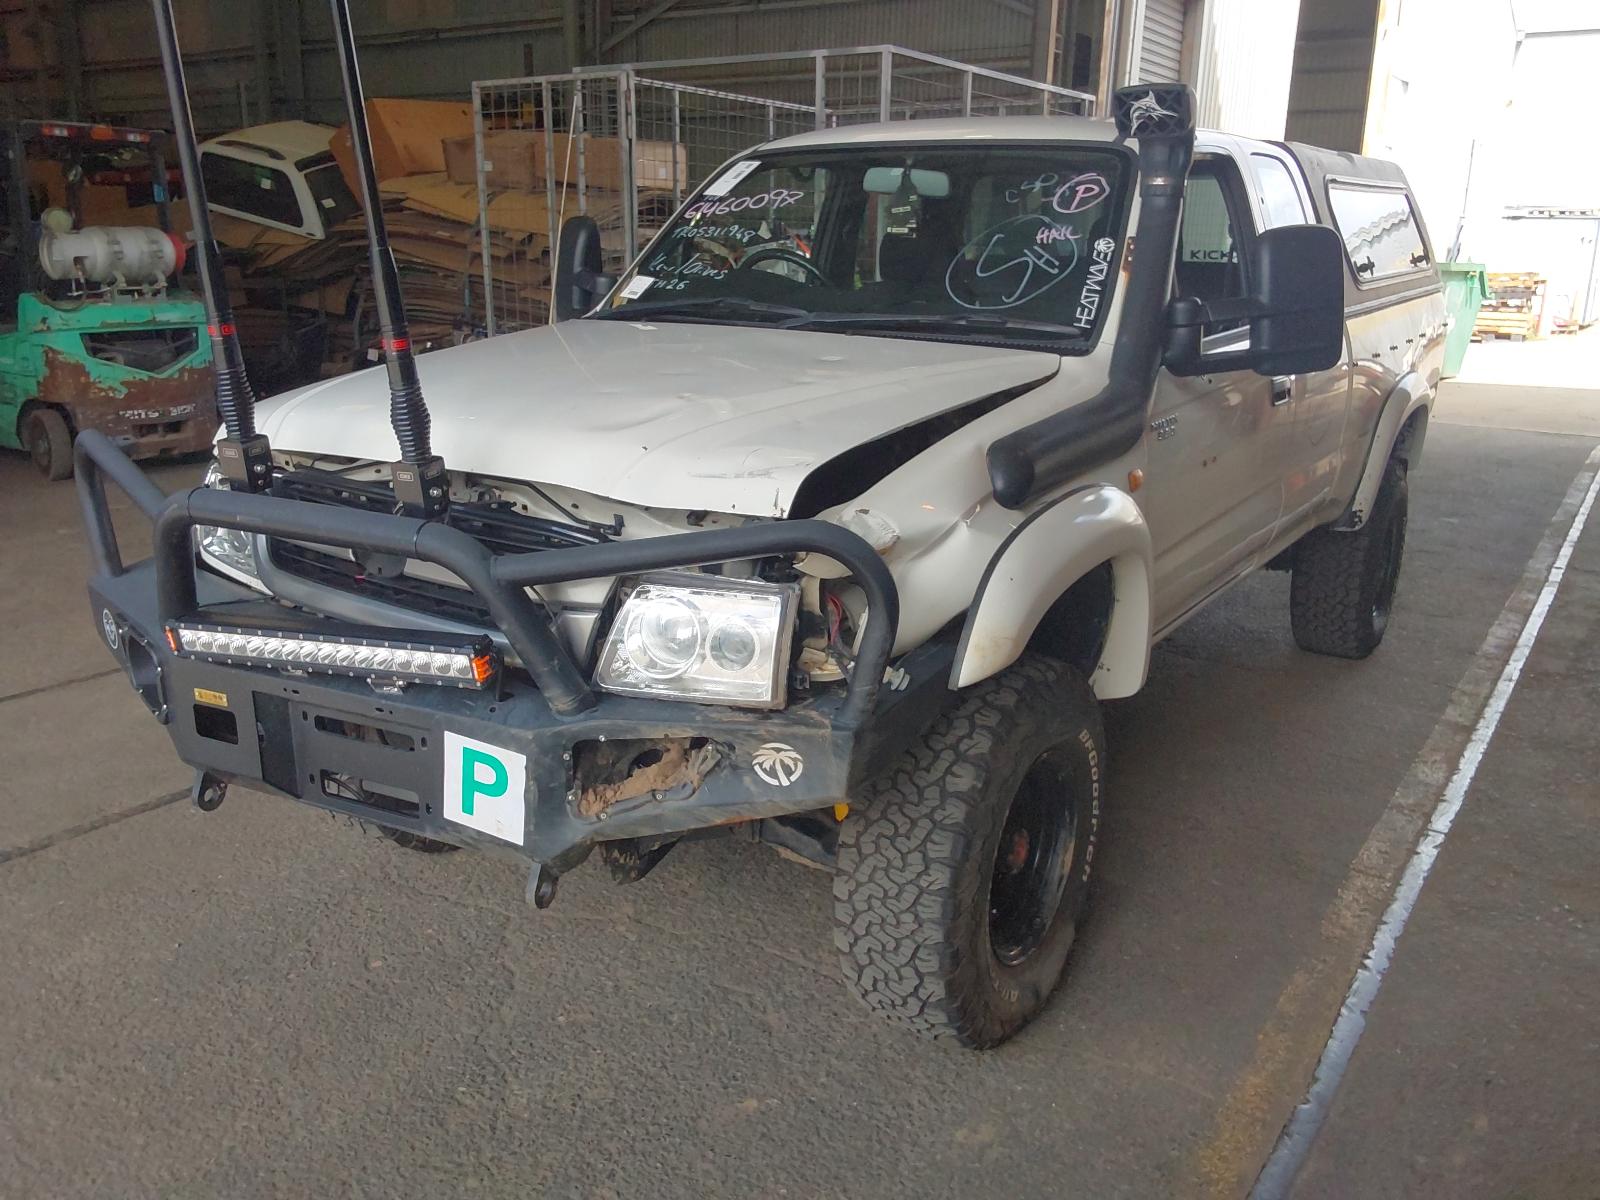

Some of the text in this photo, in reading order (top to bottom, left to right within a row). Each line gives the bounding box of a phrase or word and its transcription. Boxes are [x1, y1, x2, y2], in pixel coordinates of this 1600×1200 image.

[1069, 183, 1101, 211] P
[1073, 249, 1113, 329] HEATWAVE
[461, 746, 508, 816] P
